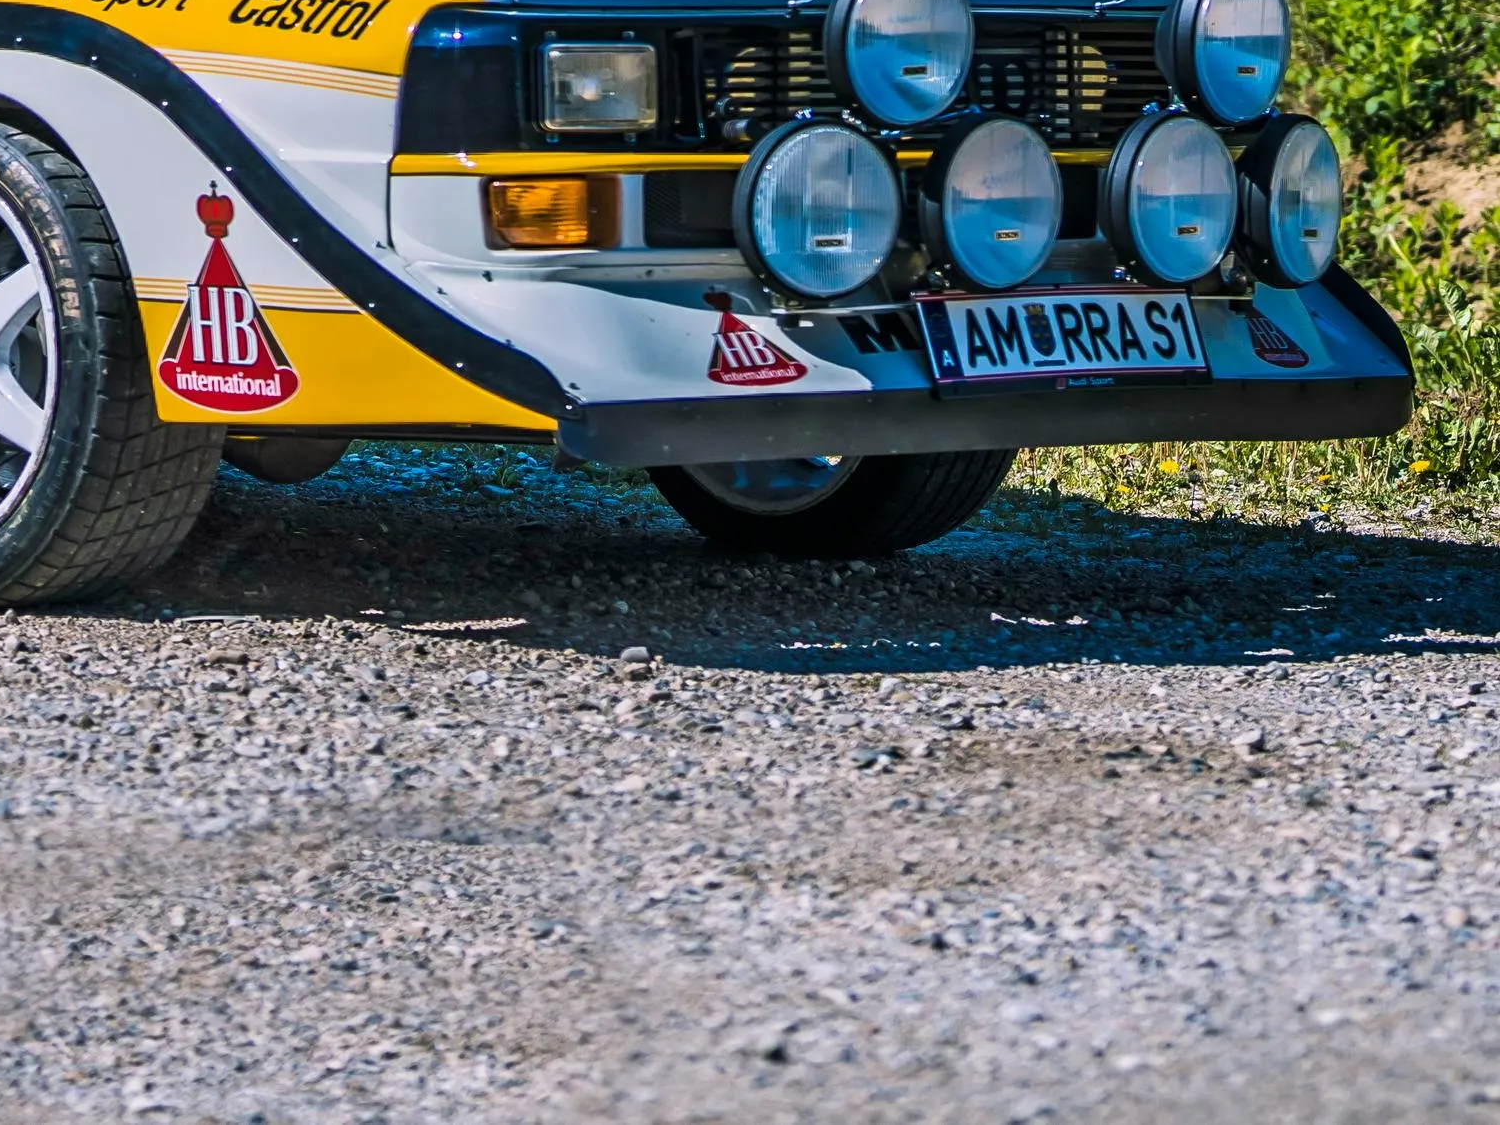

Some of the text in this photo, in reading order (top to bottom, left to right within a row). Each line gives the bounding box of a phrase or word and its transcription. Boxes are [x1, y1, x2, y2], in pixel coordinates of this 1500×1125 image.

[187, 283, 258, 367] HB
[965, 300, 1197, 369] AM RRA S1
[716, 330, 777, 369] HB
[942, 350, 955, 367] A
[175, 367, 282, 398] international
